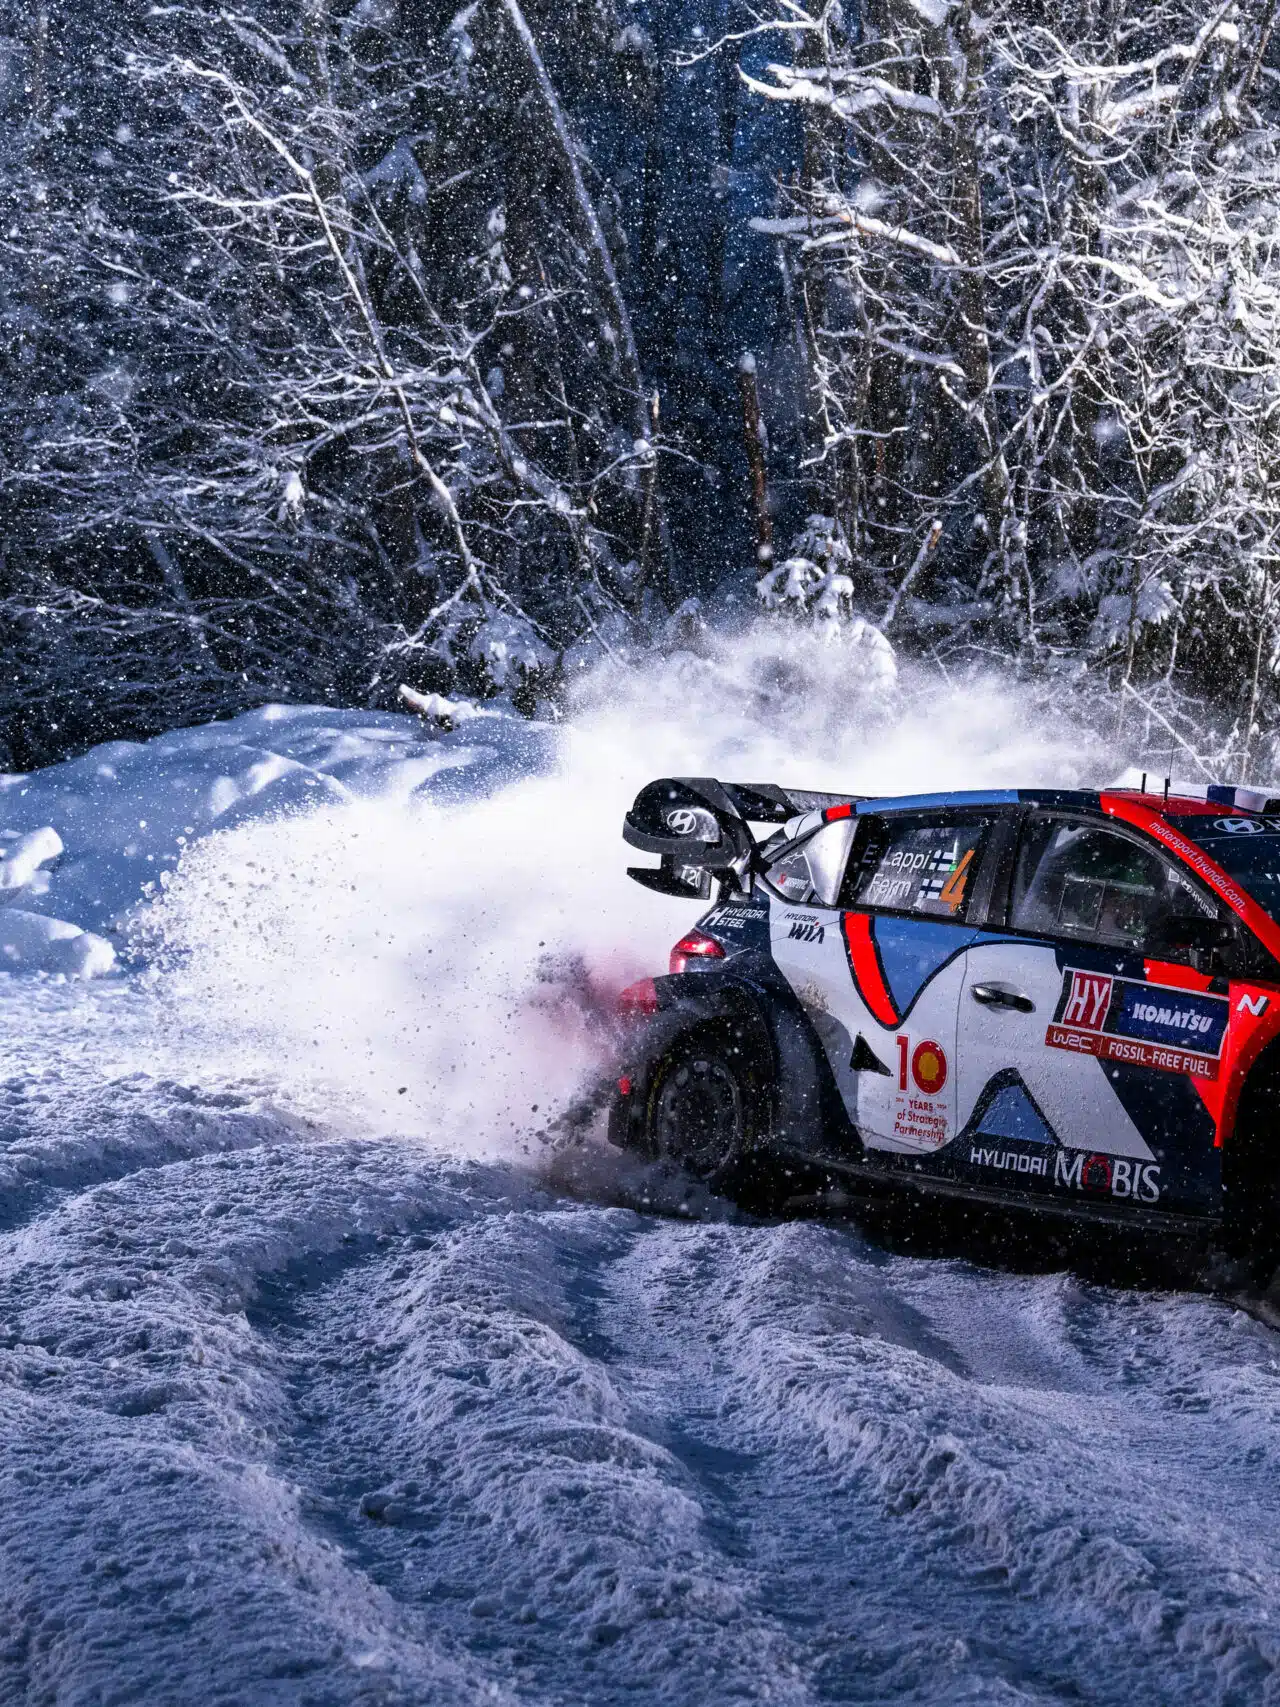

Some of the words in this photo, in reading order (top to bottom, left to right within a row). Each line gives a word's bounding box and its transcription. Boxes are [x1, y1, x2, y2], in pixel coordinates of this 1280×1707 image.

[881, 846, 932, 874] Lappi
[1149, 821, 1247, 910] motorsport.hyundai.com
[868, 873, 912, 897] Ferm
[940, 849, 976, 912] 4
[718, 917, 746, 929] STEEL
[725, 907, 767, 919] HYUNDAI
[785, 912, 819, 922] HYUNDAI
[788, 922, 825, 944] WIA
[1065, 977, 1110, 1025] HY
[1132, 1002, 1214, 1033] KOMATSU
[1052, 1030, 1096, 1050] WRC
[1109, 1041, 1181, 1069] FOSSIL-FREE
[1182, 1057, 1211, 1076] FUEL
[897, 1109, 906, 1120] of
[909, 1099, 934, 1112] YEARS
[894, 1122, 945, 1142] Partnership
[970, 1147, 1048, 1176] HYUNDAI
[1054, 1150, 1162, 1204] MOBIS
